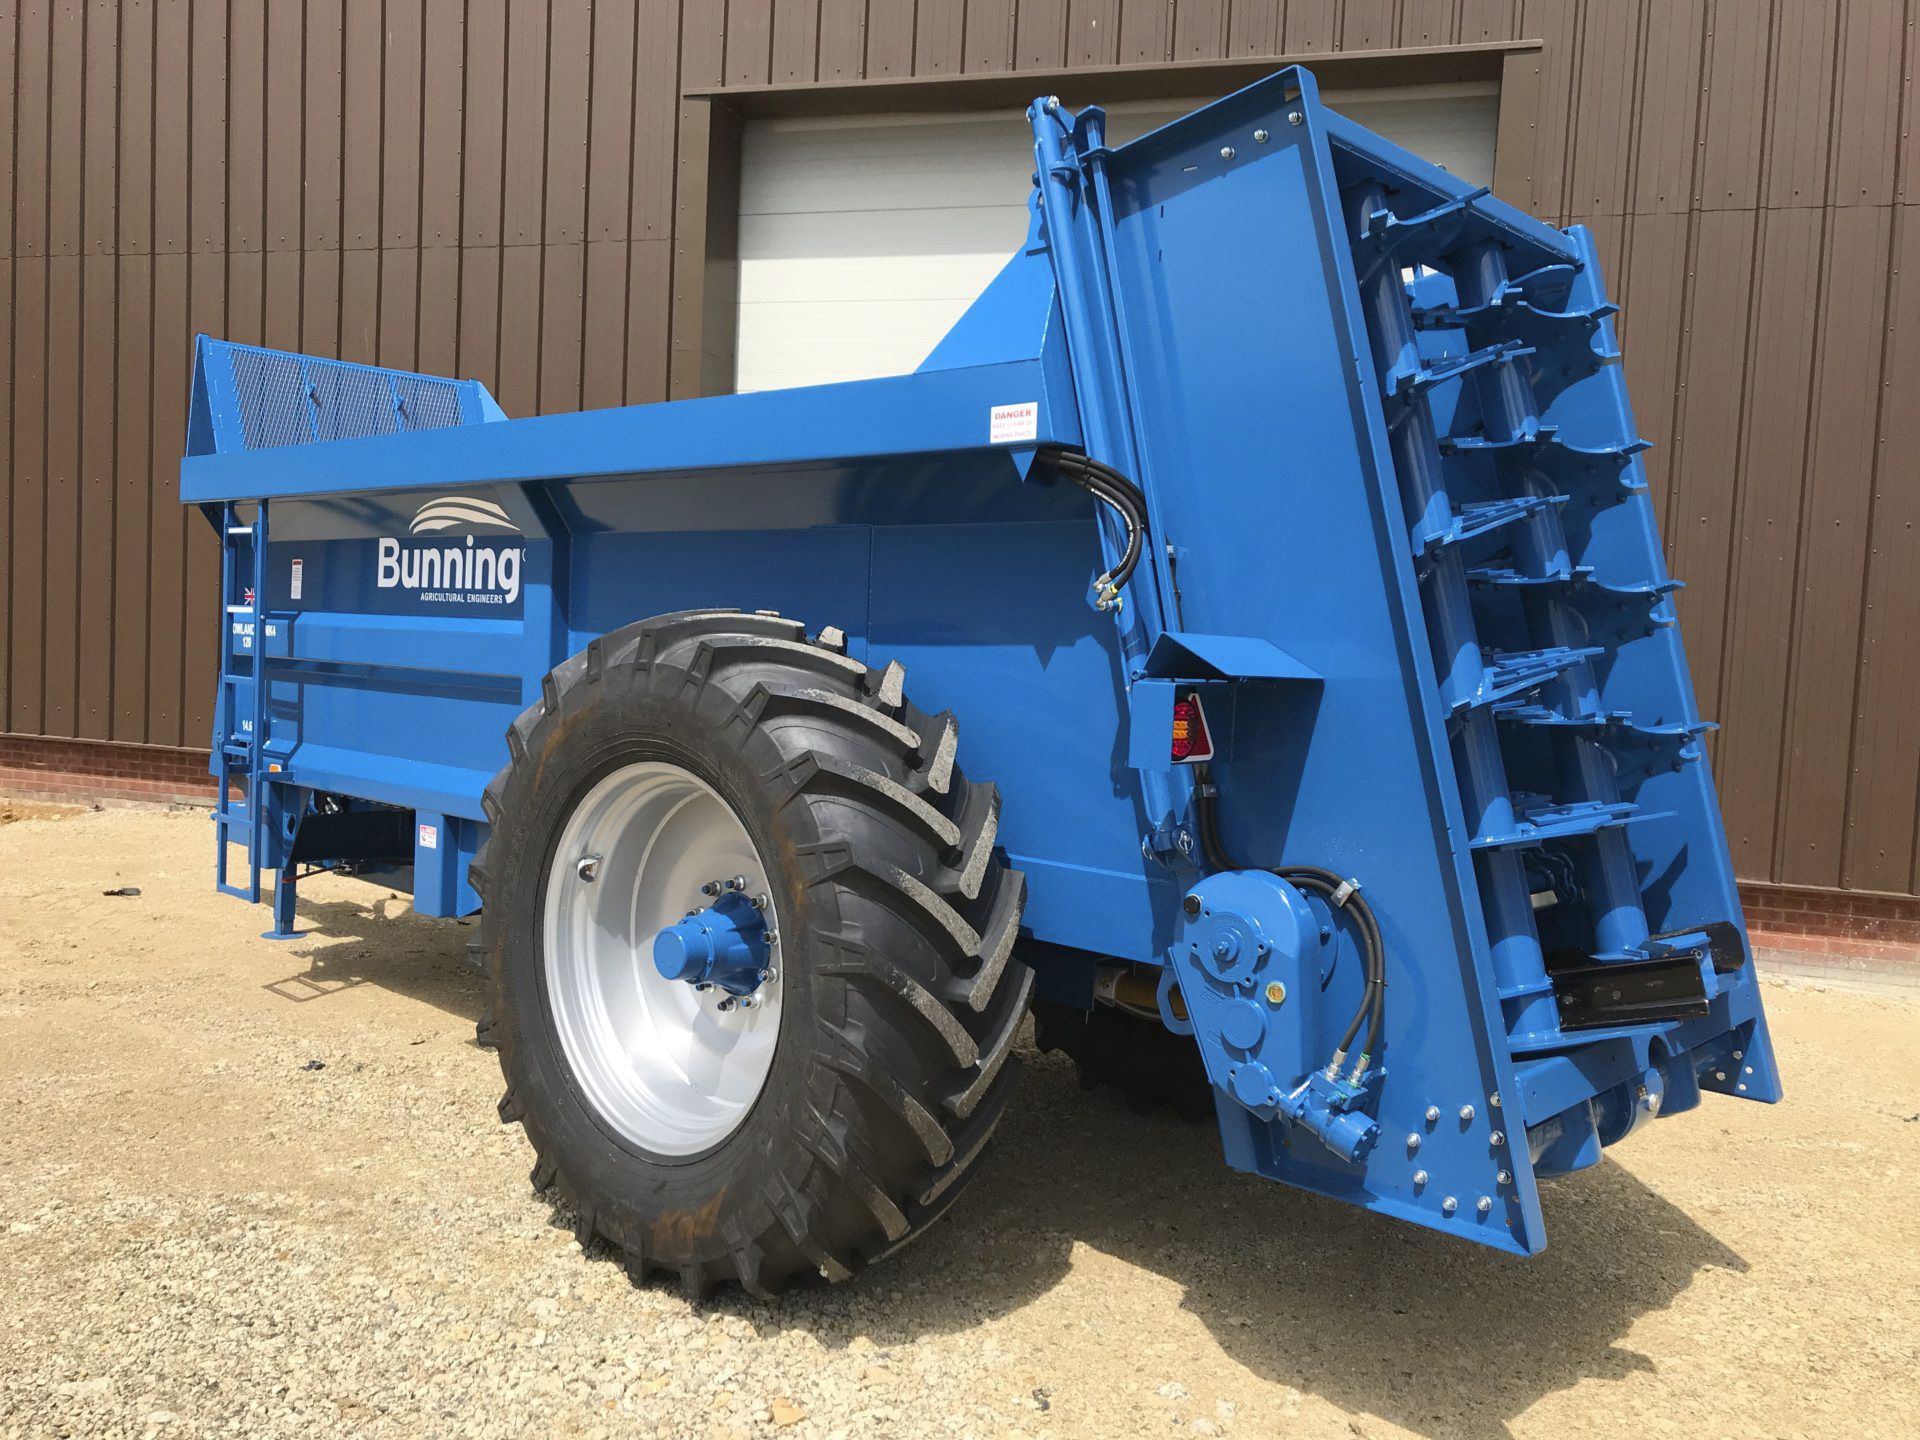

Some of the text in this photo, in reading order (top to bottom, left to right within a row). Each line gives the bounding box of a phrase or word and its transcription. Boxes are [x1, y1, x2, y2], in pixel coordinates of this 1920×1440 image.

[995, 408, 1032, 420] DANGER
[377, 534, 521, 604] Bunning
[420, 592, 503, 604] AGRICULTURAL ENGINEERS
[242, 636, 252, 648] 120
